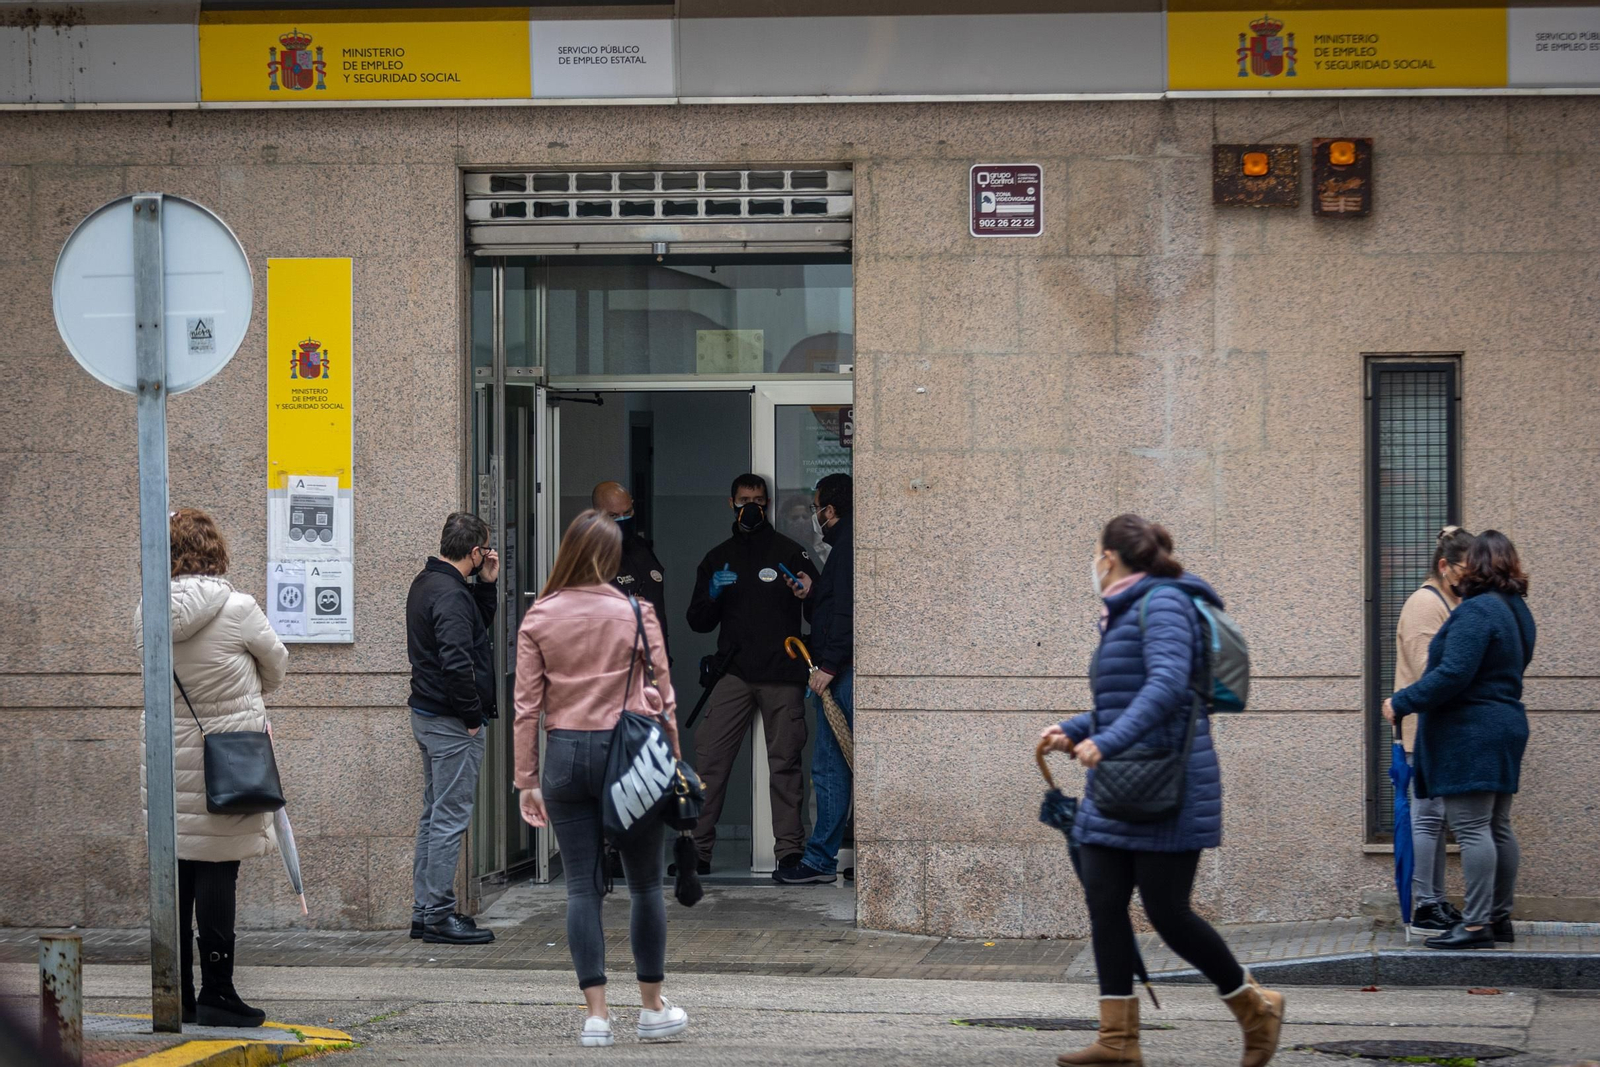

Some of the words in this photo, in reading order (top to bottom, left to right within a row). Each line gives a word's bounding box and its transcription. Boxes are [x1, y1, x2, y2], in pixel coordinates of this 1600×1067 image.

[1314, 33, 1378, 44] MINISTERIO
[1536, 32, 1577, 41] SERVICIO
[558, 46, 598, 54] SERVICIO
[600, 44, 640, 54] PÚBLICO
[1314, 47, 1329, 57] DE
[1332, 46, 1376, 57] EMPLEO
[1536, 43, 1548, 51] DE
[1550, 42, 1588, 51] EMPLEO
[342, 48, 405, 58] MINISTERIO
[343, 61, 358, 70] DE
[361, 60, 404, 70] EMPLEO
[558, 56, 571, 64] DE
[573, 56, 608, 64] EMPLEO
[610, 56, 646, 64] ESTATAL
[1314, 60, 1322, 70] Y
[1324, 60, 1390, 70] SEGURIDAD
[1393, 59, 1436, 70] SOCIAL
[344, 74, 350, 83] Y
[354, 73, 418, 83] SEGURIDAD
[420, 72, 460, 82] SOCIAL
[611, 726, 676, 830] NIKE
